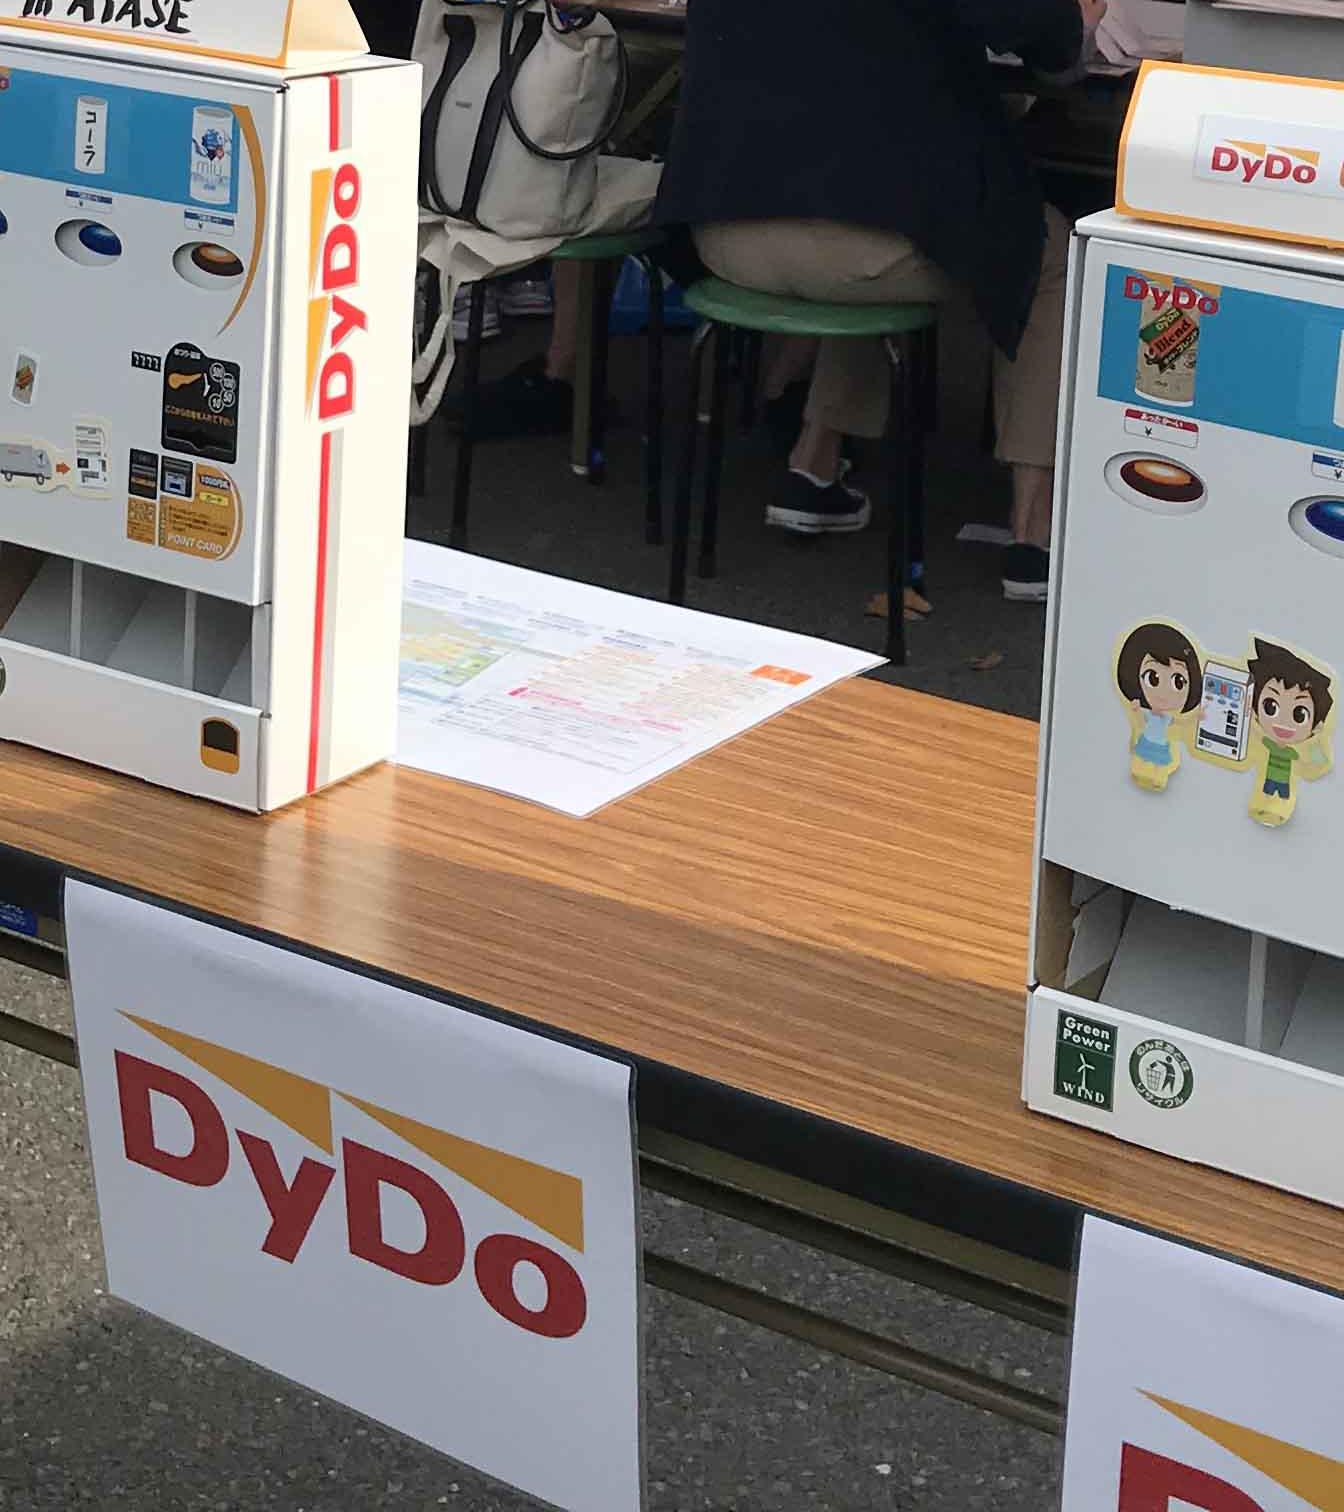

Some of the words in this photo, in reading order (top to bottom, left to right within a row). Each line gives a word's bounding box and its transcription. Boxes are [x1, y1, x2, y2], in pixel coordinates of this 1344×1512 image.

[83, 110, 97, 166] コーラ
[1211, 147, 1317, 184] DyDo
[318, 163, 369, 421] DyDo
[1123, 275, 1219, 316] DyDo
[1062, 1028, 1111, 1052] Power
[1064, 1015, 1111, 1040] Green
[1062, 1081, 1105, 1104] WIND
[112, 1047, 589, 1340] DyDo
